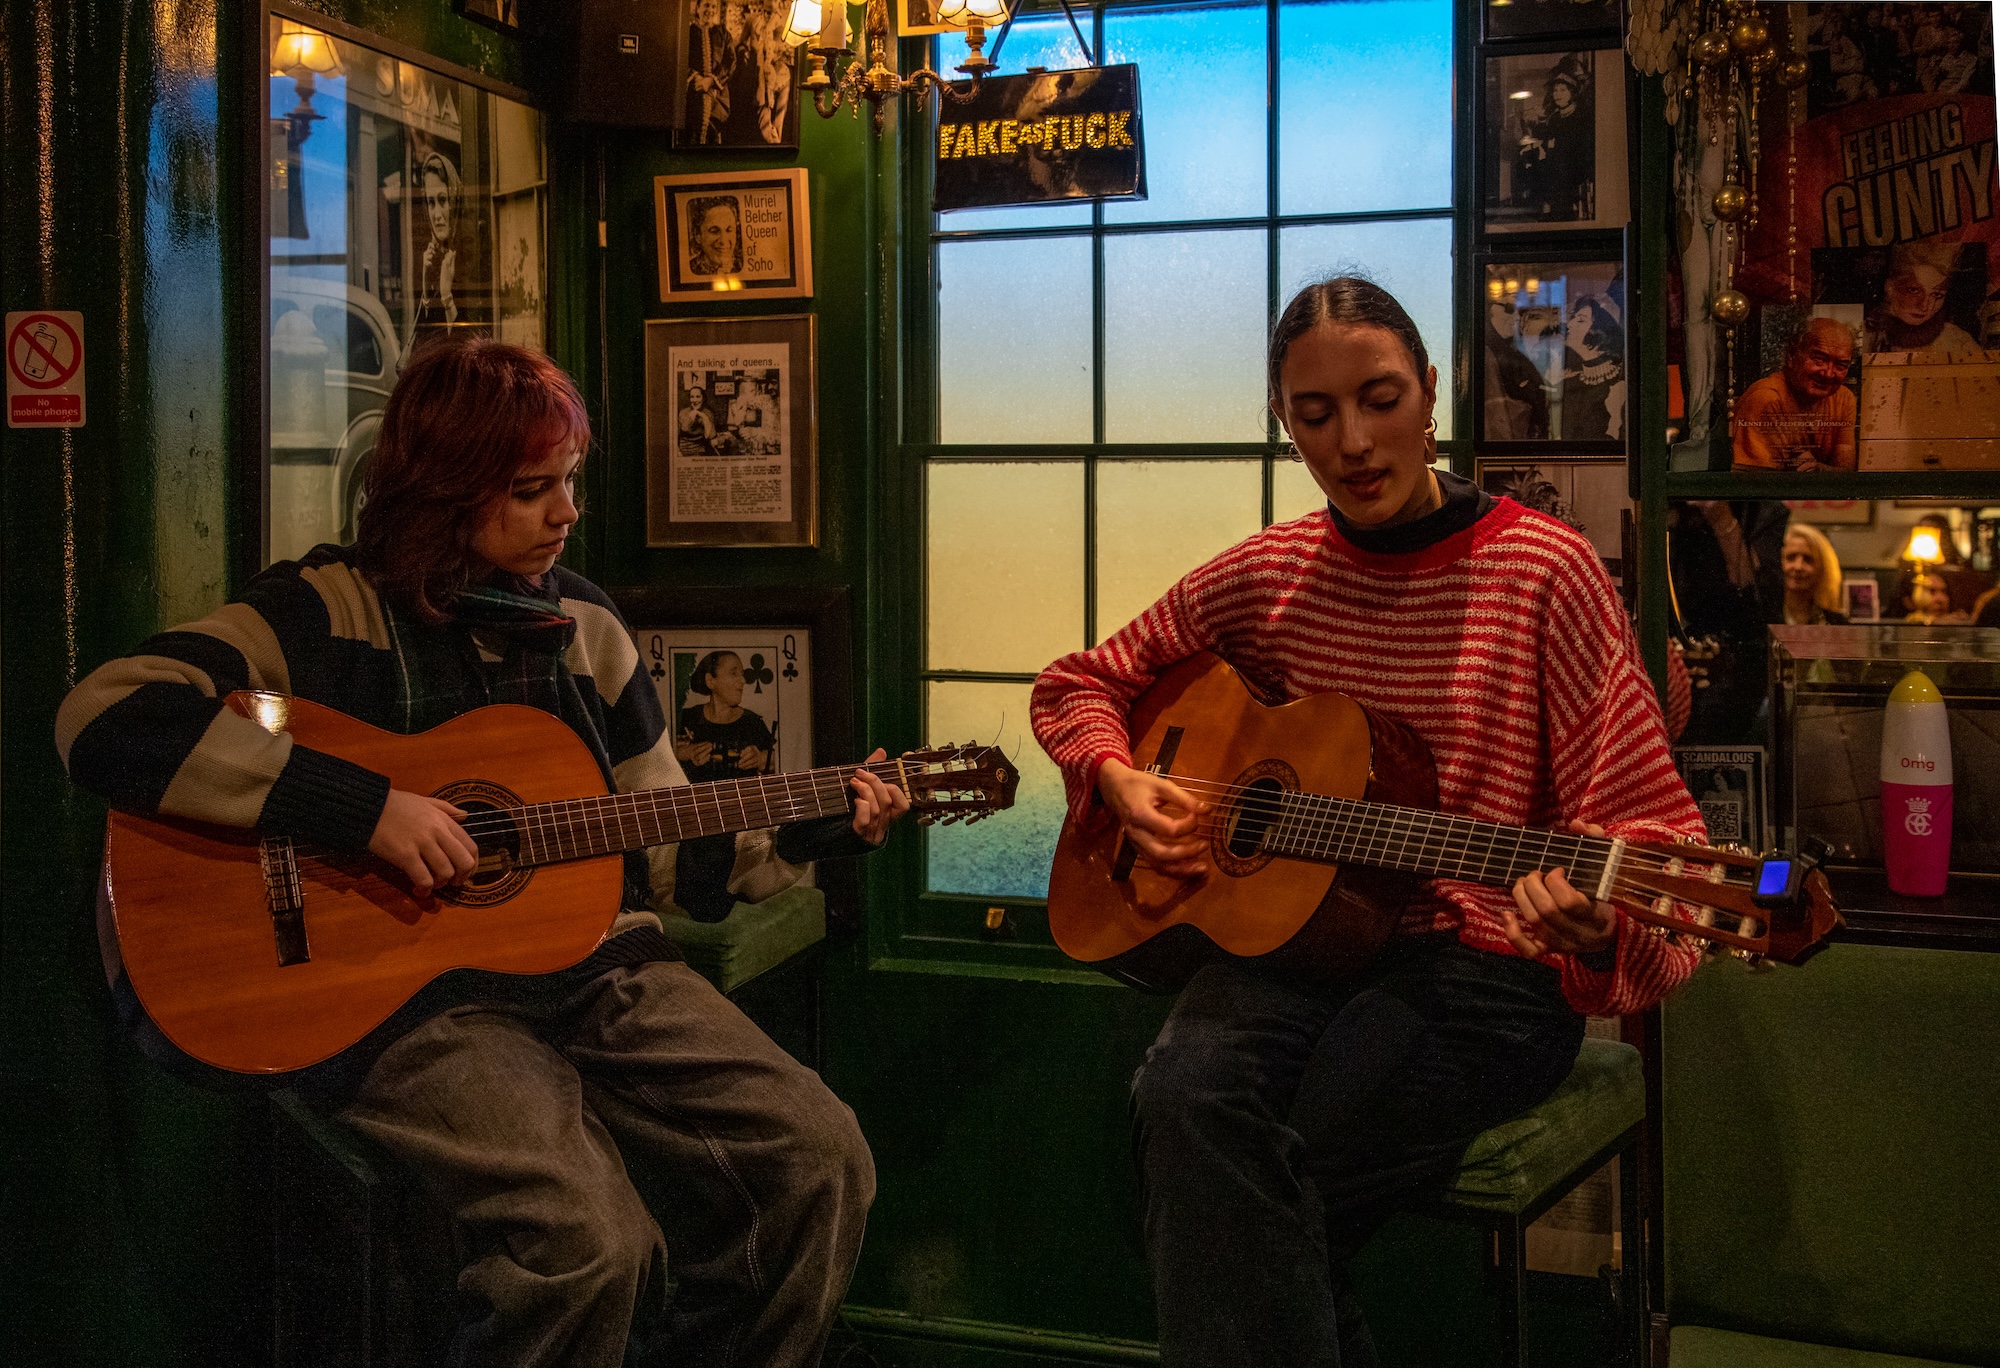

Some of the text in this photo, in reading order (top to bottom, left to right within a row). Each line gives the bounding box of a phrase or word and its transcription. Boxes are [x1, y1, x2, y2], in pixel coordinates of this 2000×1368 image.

[939, 110, 1134, 159] FAKE AS FUCK
[1841, 102, 1964, 180] FEELING
[744, 193, 776, 208] Muriel
[1822, 138, 1995, 248] CUNTY
[745, 209, 782, 223] Belcher
[746, 225, 778, 241] Queen
[746, 242, 757, 256] of
[747, 257, 773, 272] Soho
[677, 359, 693, 368] And
[698, 358, 726, 368] talking
[730, 358, 739, 367] of
[13, 408, 79, 417] mobile phones
[651, 634, 665, 661] Q
[783, 634, 797, 661] Q
[1682, 752, 1755, 763] SCANDALOUS
